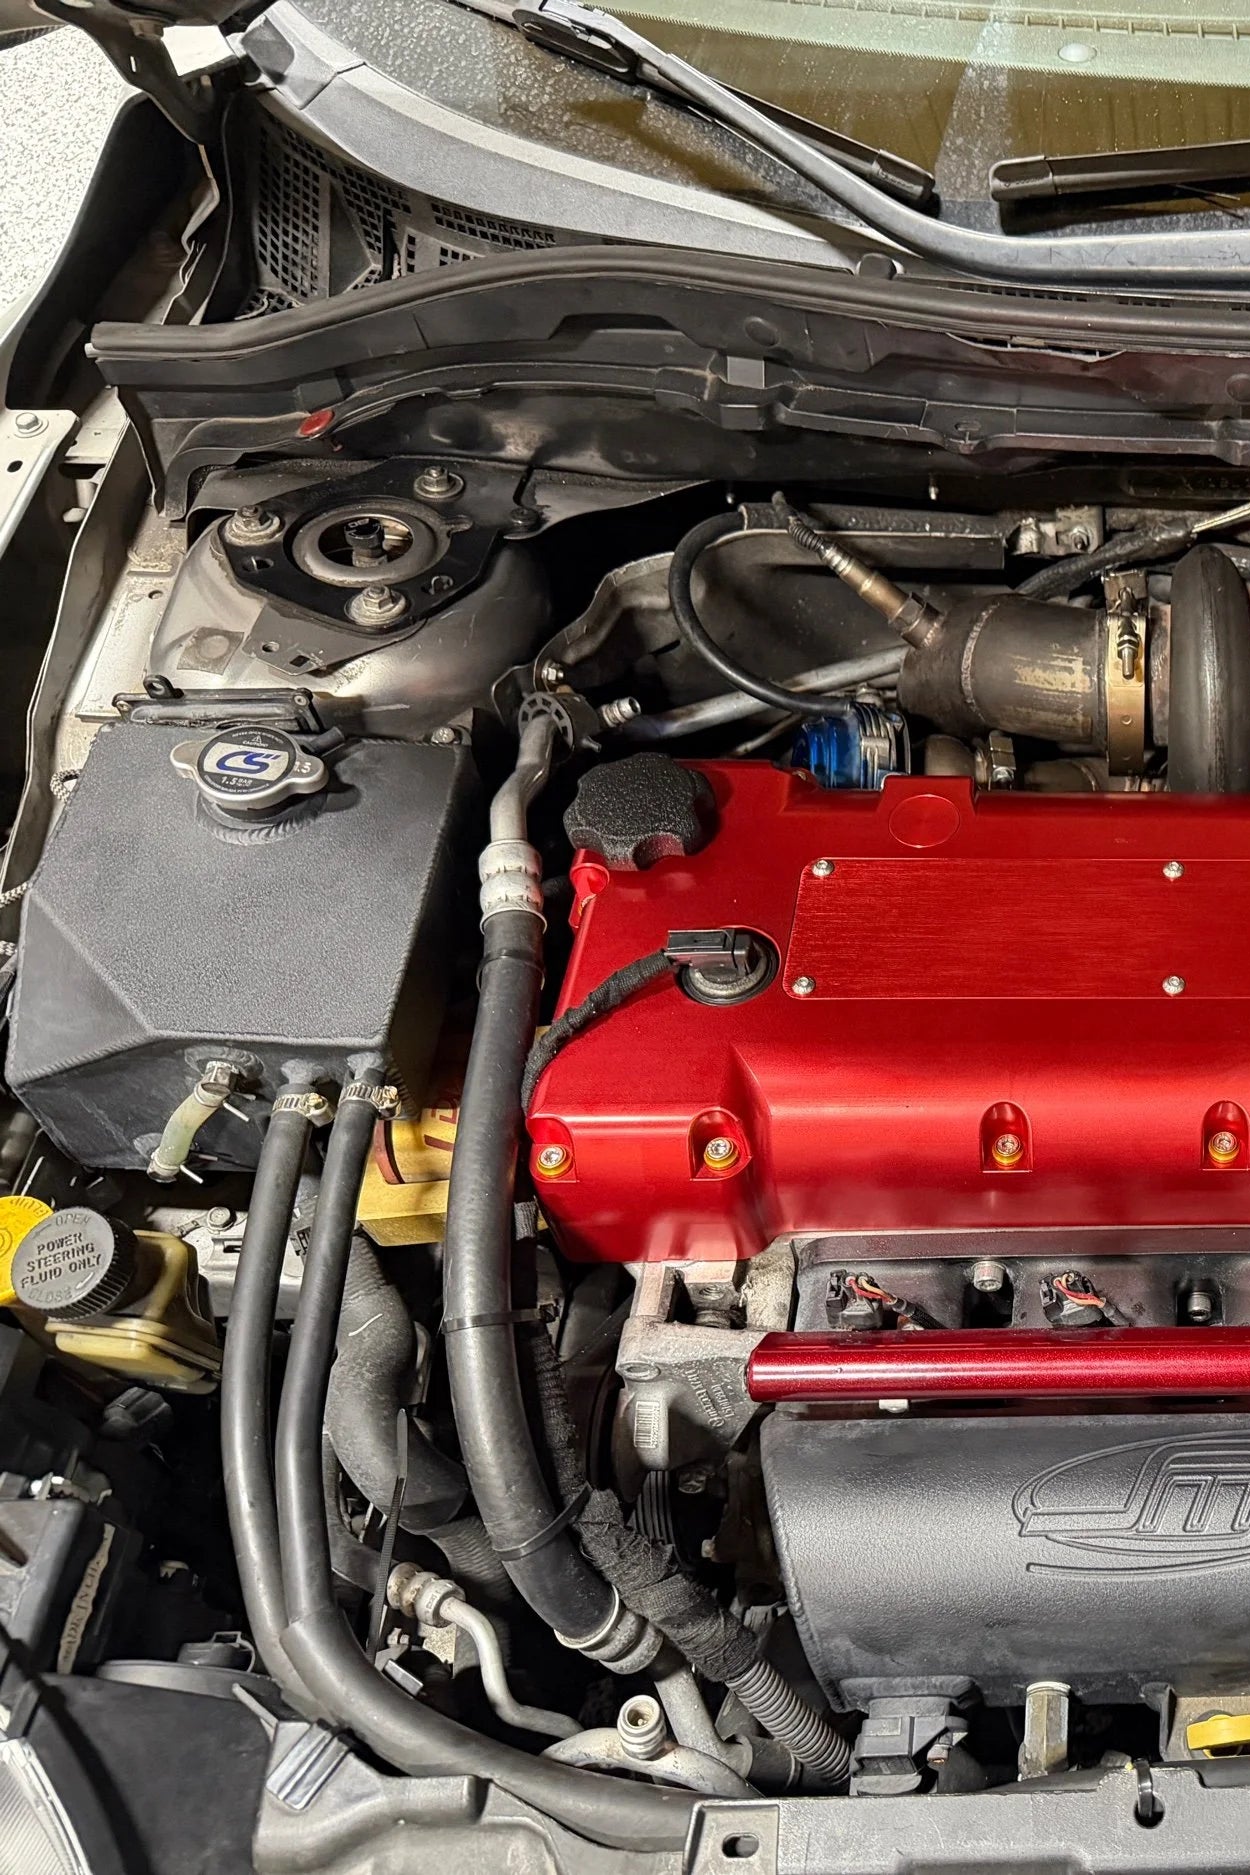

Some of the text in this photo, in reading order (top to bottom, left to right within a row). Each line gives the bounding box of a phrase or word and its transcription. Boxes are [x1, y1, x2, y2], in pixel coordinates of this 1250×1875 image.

[56, 1213, 91, 1226] OPEN
[37, 1232, 82, 1255] POWER
[27, 1242, 95, 1272] STEERING
[21, 1253, 102, 1288] FLUID ONLY
